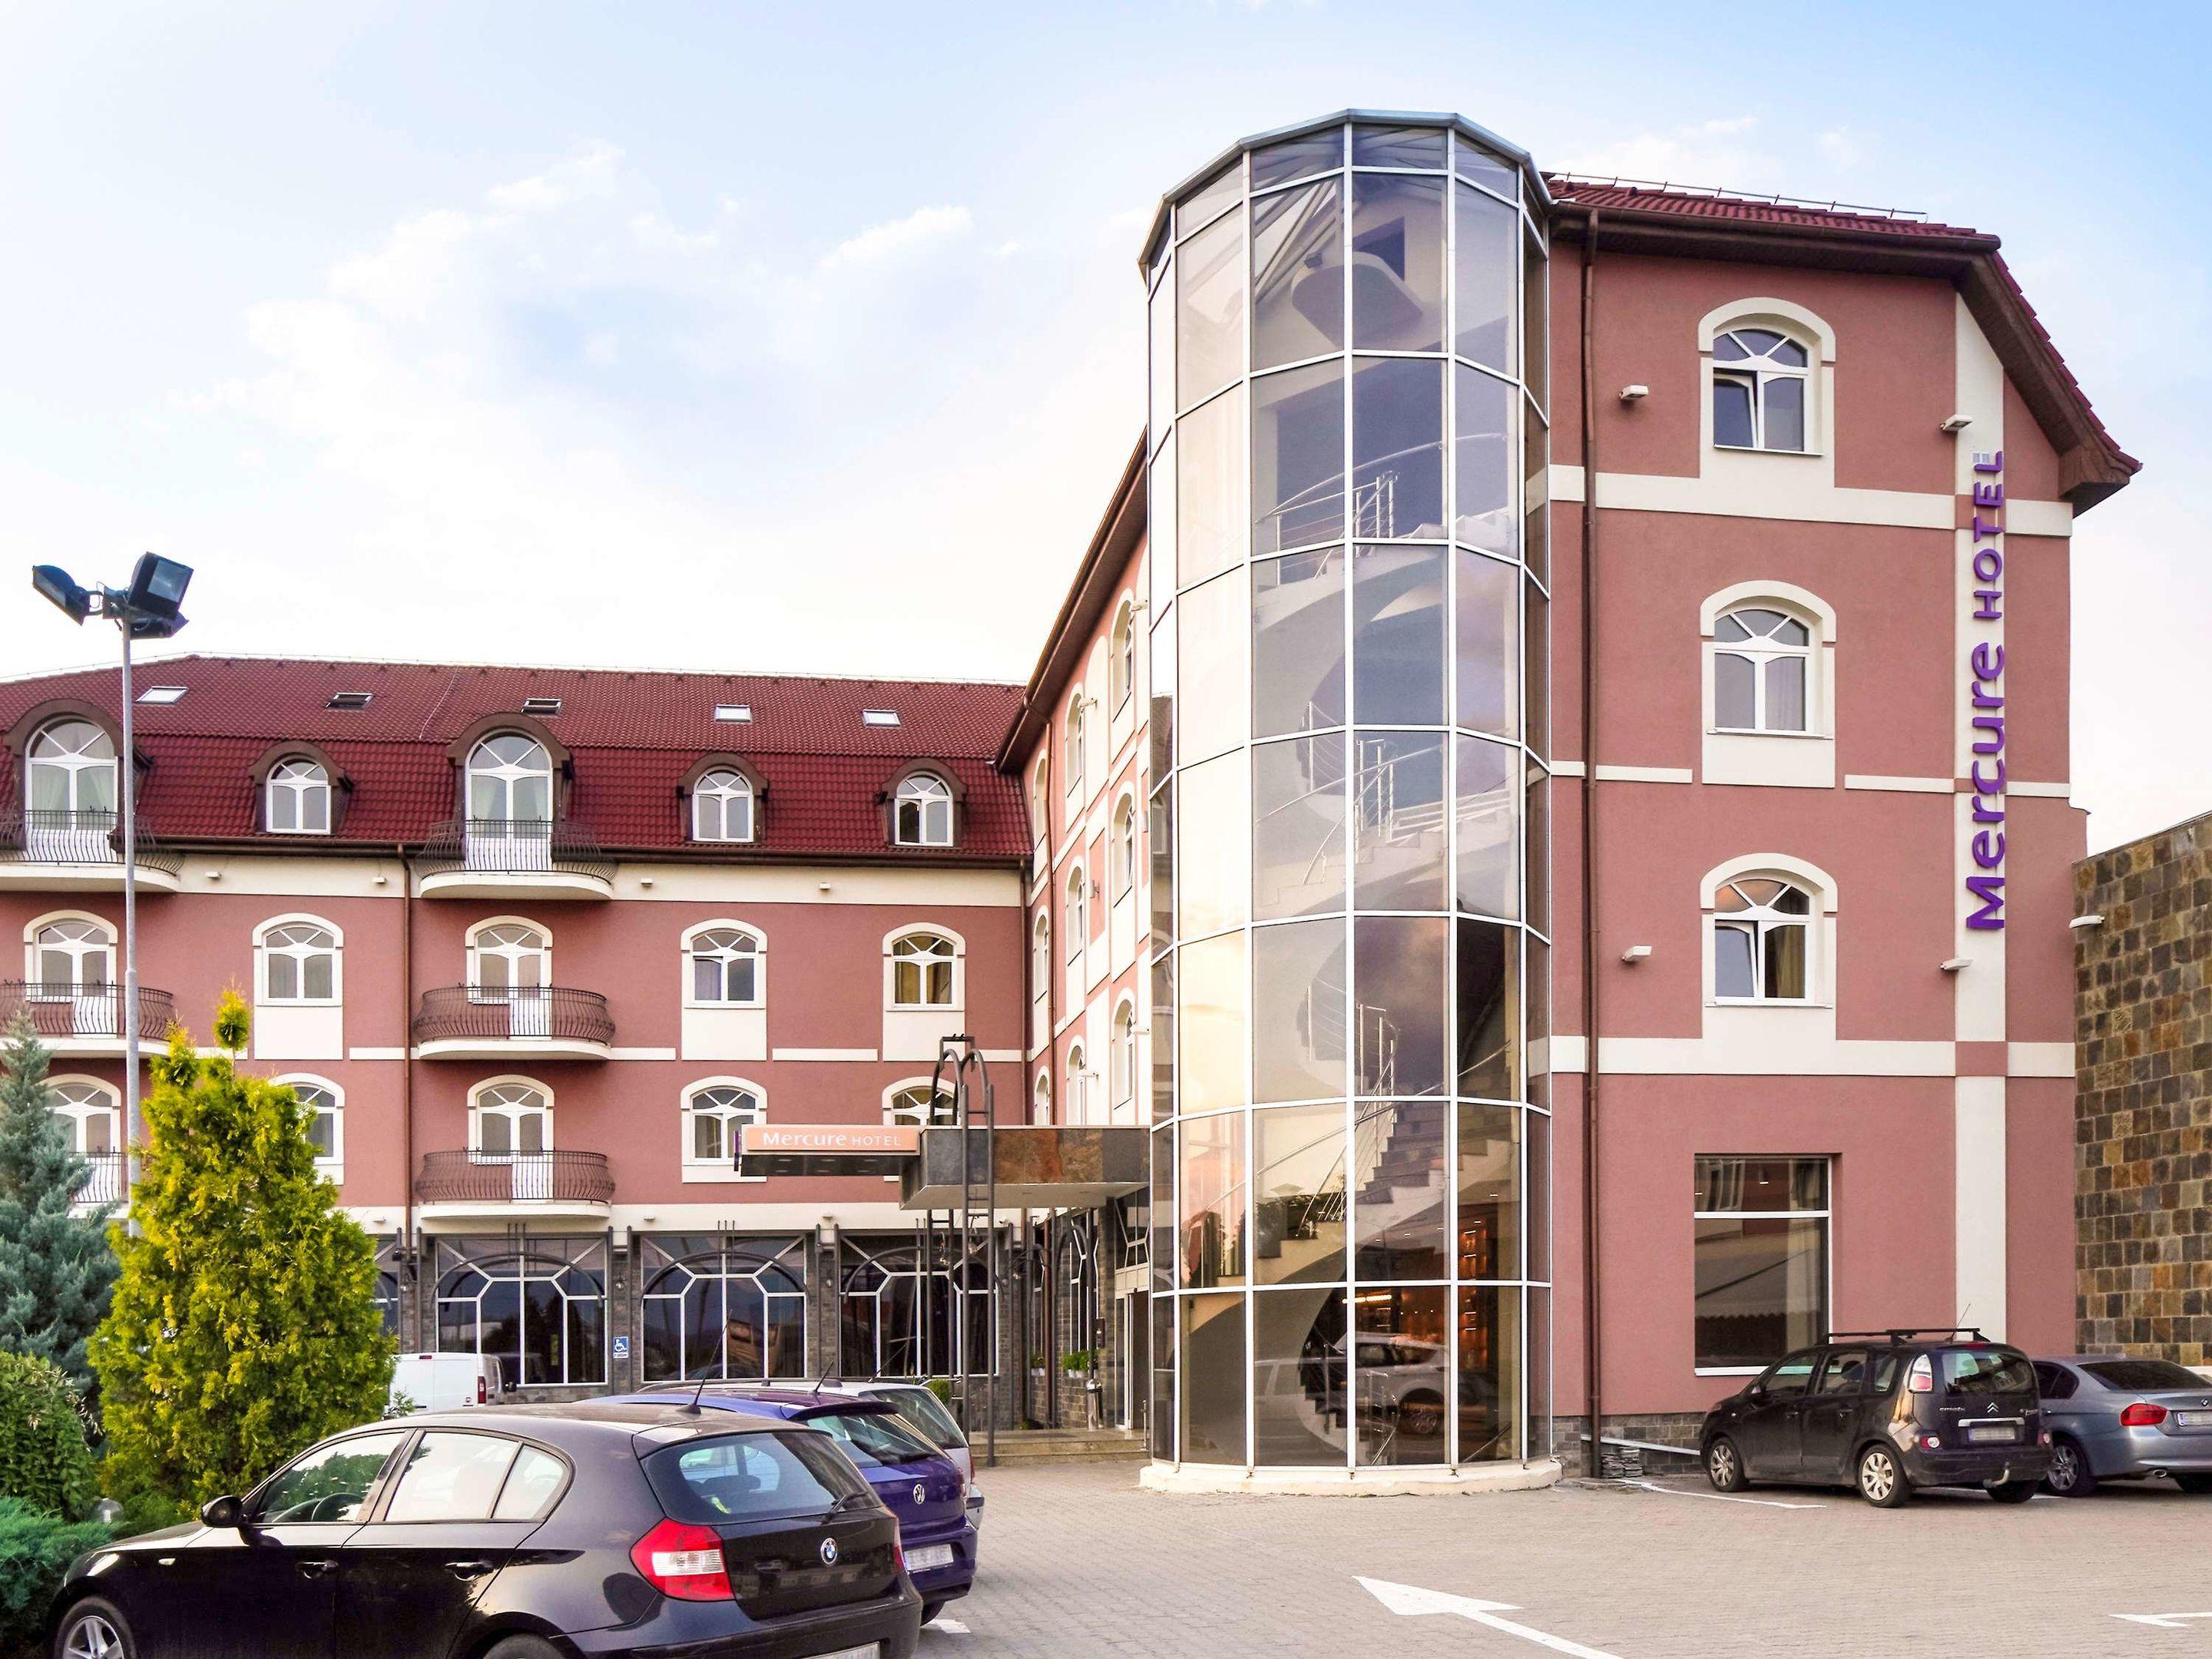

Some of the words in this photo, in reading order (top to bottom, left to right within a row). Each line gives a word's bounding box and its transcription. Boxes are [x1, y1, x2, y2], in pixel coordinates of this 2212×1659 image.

[1973, 451, 2003, 619] HOTEL
[1966, 643, 2005, 929] Mercure
[763, 1132, 847, 1147] Mercure
[852, 1136, 902, 1147] HOTEL
